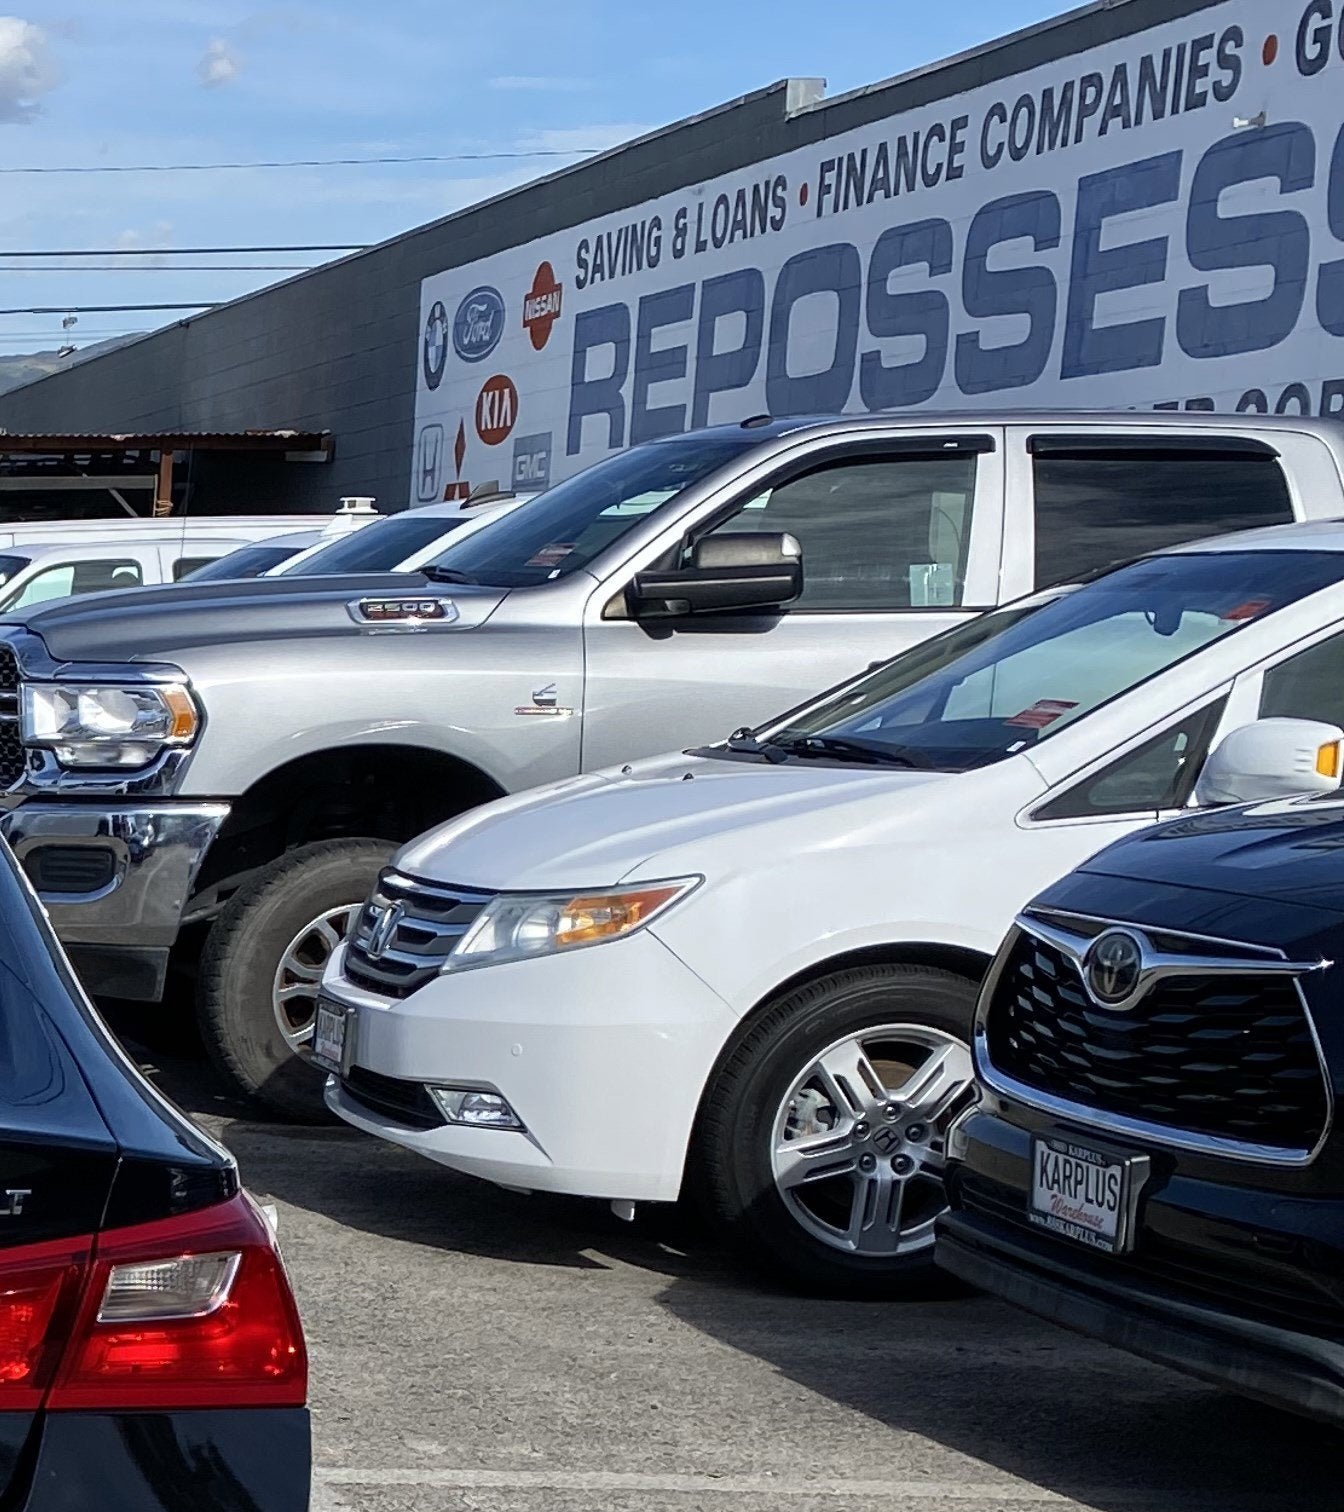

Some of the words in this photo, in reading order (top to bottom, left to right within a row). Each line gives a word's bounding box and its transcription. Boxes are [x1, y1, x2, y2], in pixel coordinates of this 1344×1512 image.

[575, 215, 663, 290] SAVING
[672, 206, 689, 260] &
[695, 174, 787, 254] LOANS
[817, 114, 969, 219] FINANCE
[981, 25, 1244, 170] COMPANIES
[1296, 0, 1344, 77] G
[525, 289, 562, 321] NISSAN
[567, 121, 1344, 457] REPOSSES
[463, 302, 496, 345] Ford
[480, 388, 512, 431] KIA
[515, 452, 546, 481] GMC
[367, 602, 436, 613] 2500
[1039, 1150, 1119, 1212] KARPLUS
